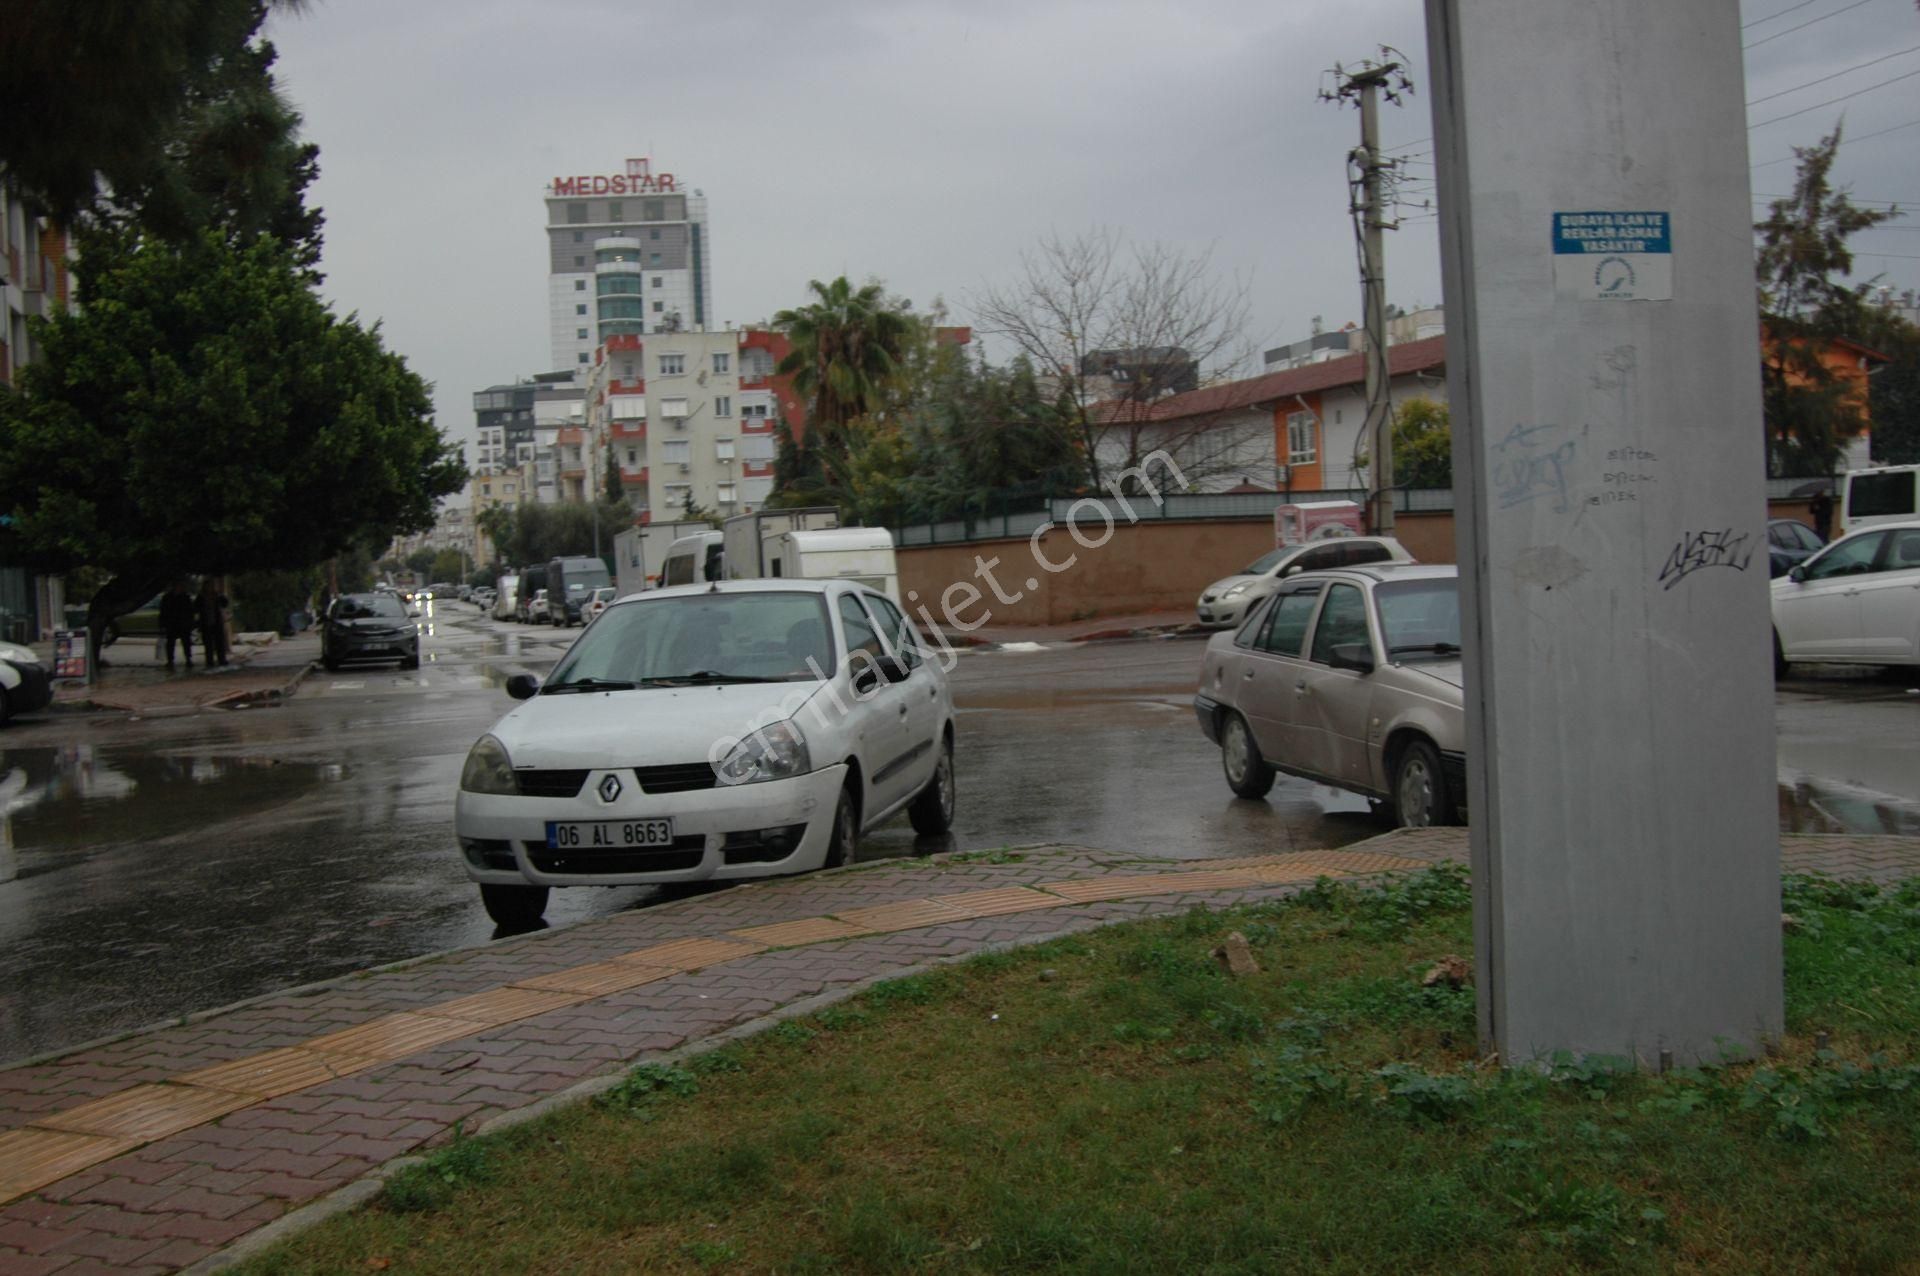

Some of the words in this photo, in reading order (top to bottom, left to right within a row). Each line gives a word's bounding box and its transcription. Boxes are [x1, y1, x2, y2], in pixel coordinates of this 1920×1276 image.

[554, 173, 675, 195] MEDSTAR
[558, 826, 579, 845] 06
[593, 825, 613, 845] AL
[624, 823, 669, 843] 8663
